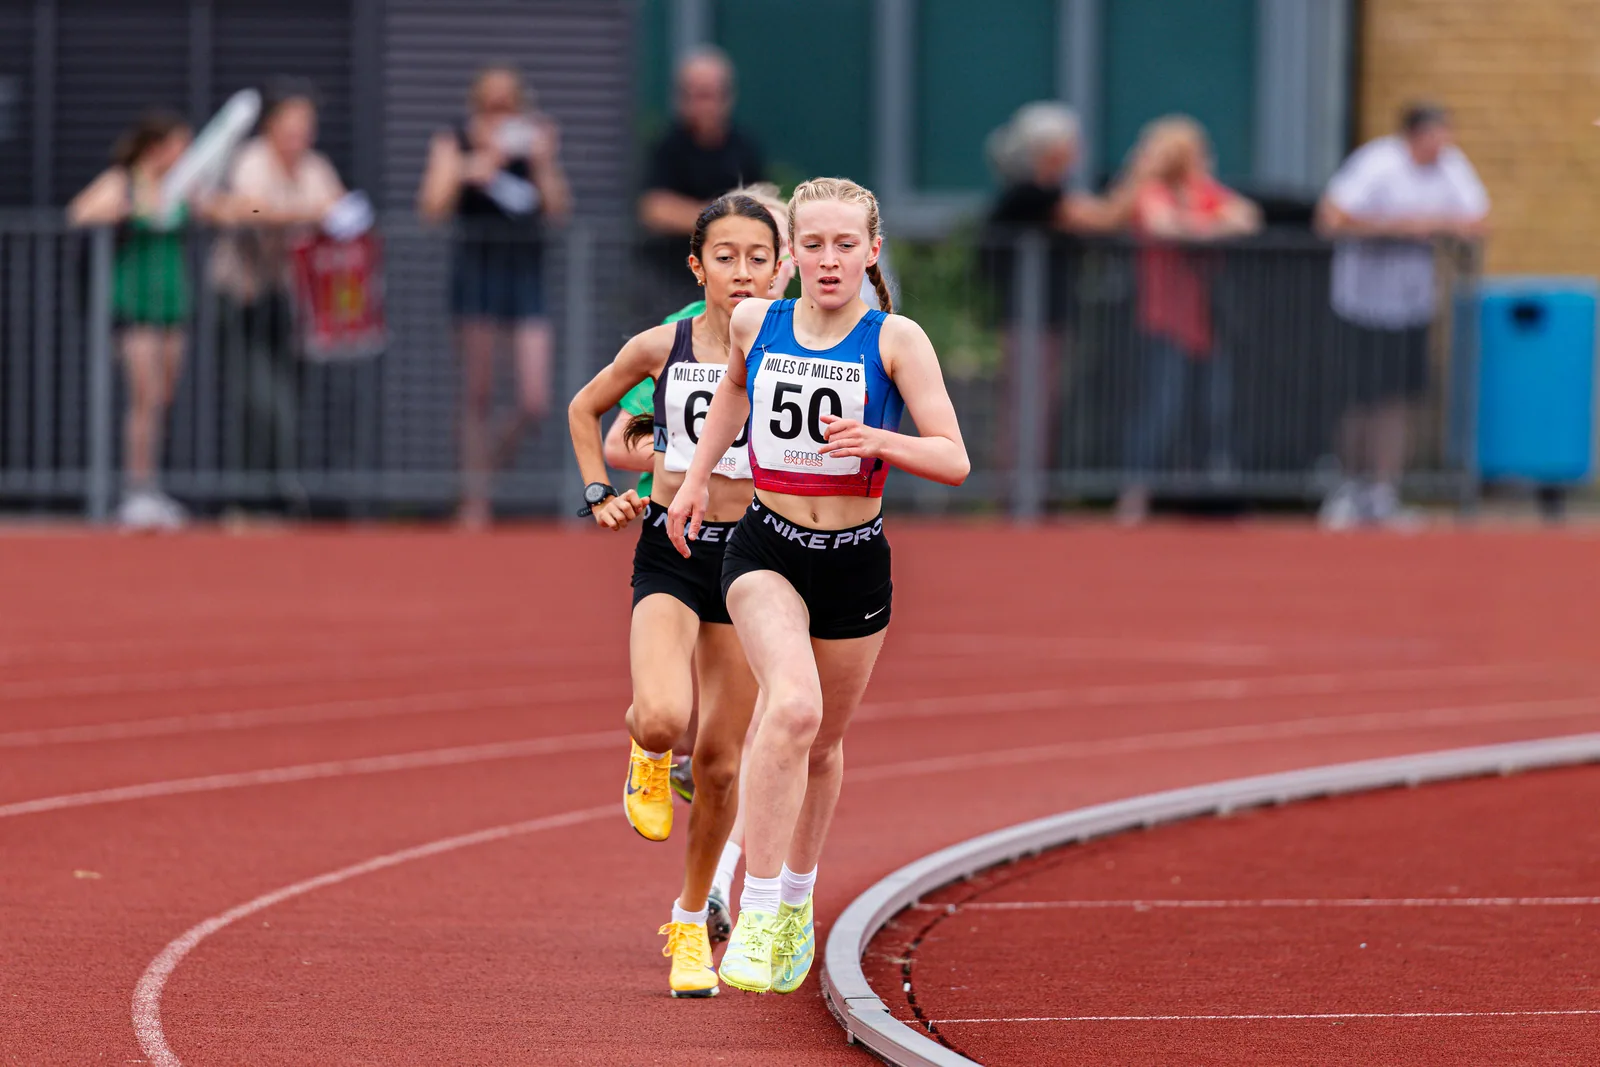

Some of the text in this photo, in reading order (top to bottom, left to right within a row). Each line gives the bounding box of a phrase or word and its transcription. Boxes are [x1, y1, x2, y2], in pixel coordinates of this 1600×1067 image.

[673, 368, 721, 383] MILES OF
[764, 358, 860, 382] MILES OF MILES 26
[769, 381, 843, 444] 50
[784, 449, 823, 461] comms
[784, 455, 823, 467] express
[763, 512, 883, 549] NIKE PRO
